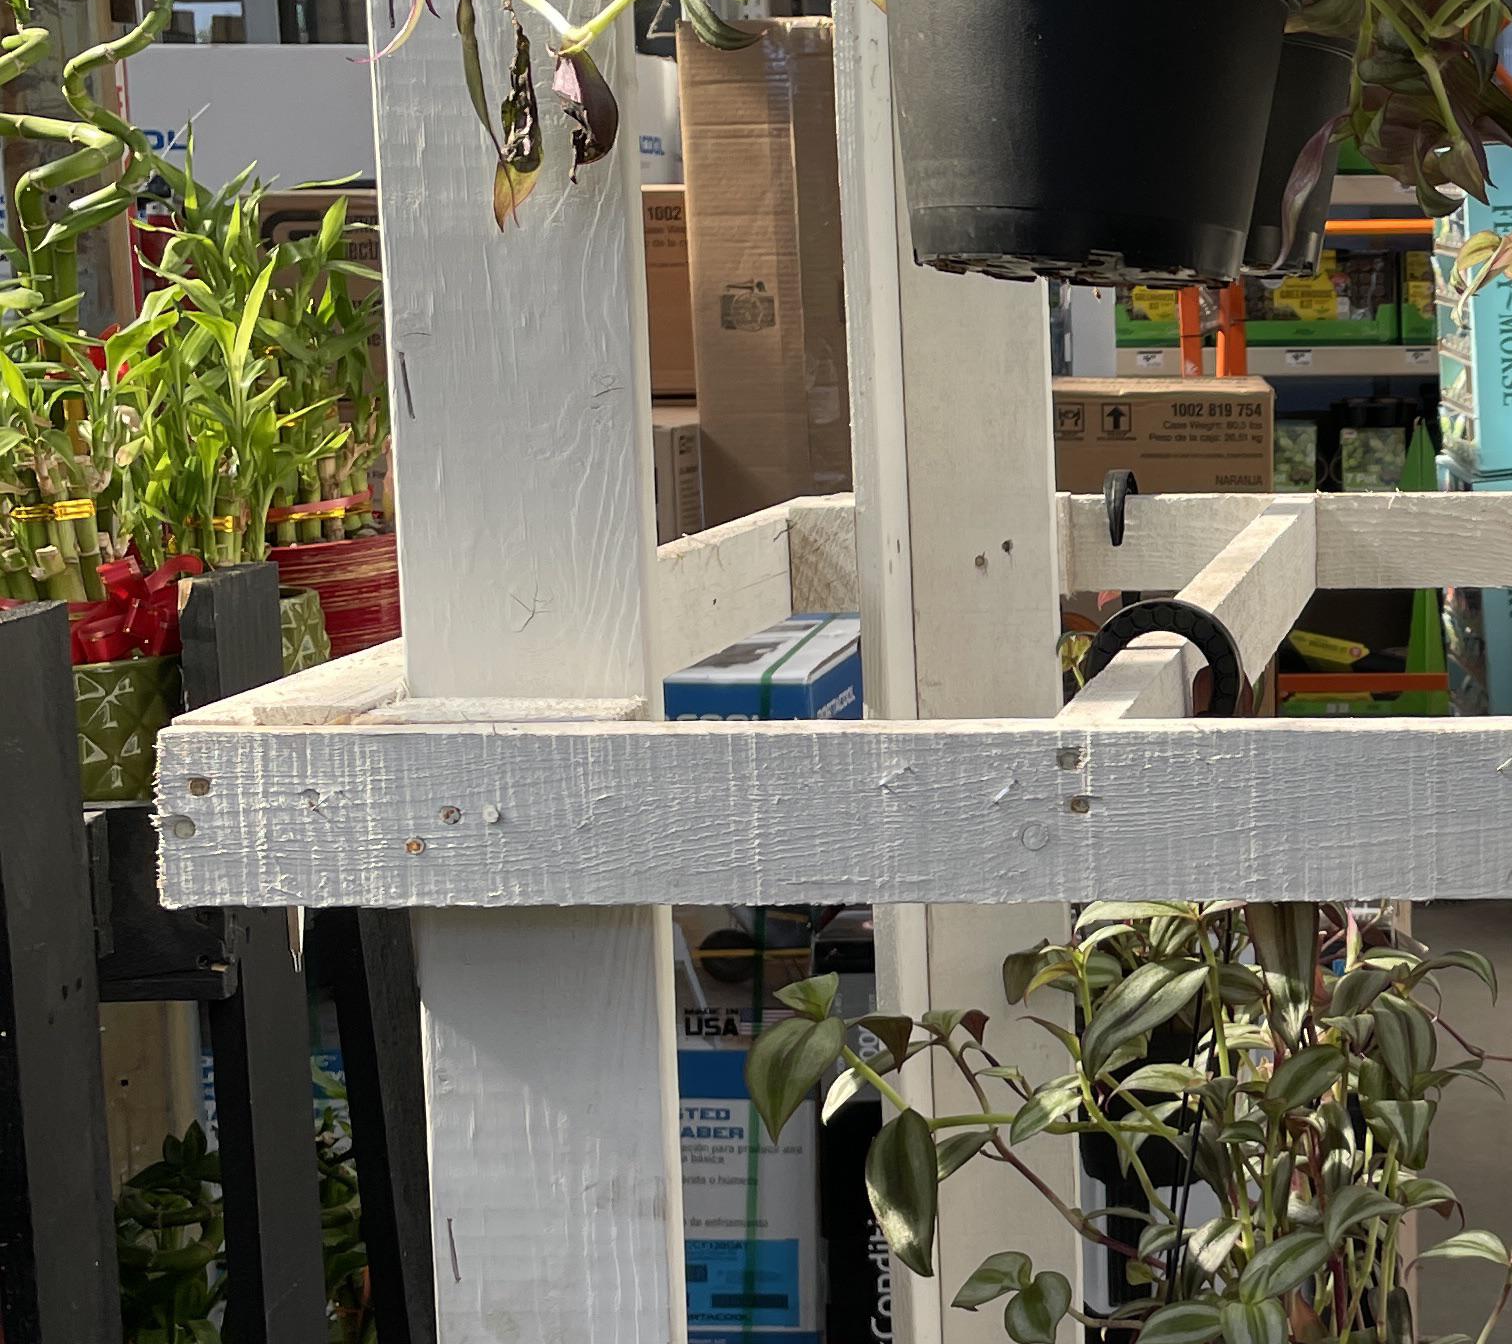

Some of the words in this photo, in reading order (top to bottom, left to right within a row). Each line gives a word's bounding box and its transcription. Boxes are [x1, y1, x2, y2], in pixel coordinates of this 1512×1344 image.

[647, 206, 682, 221] 1002
[1171, 403, 1203, 417] 1002
[1209, 403, 1232, 417] 819
[1237, 403, 1262, 417] 754
[726, 1008, 739, 1016] IN
[685, 1017, 739, 1036] USA
